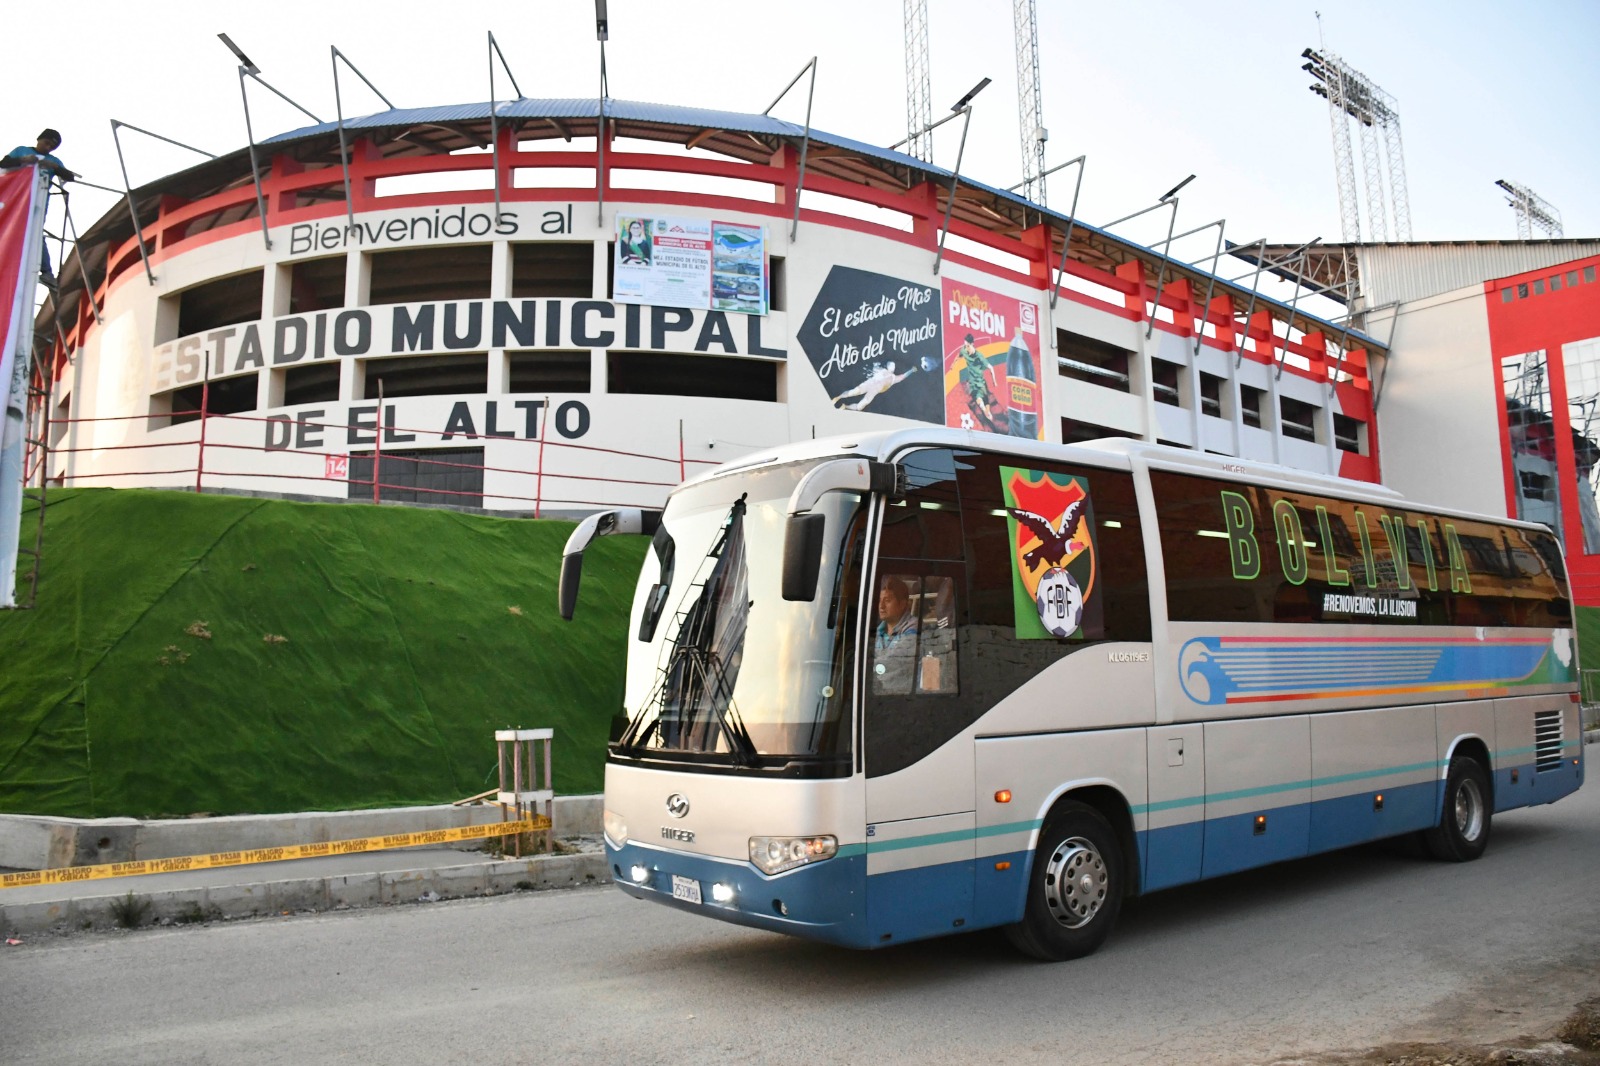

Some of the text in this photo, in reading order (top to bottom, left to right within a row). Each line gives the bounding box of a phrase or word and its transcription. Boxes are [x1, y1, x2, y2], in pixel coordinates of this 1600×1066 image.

[290, 204, 572, 255] Bienvenidos al
[819, 307, 841, 337] El
[844, 295, 897, 328] estadio
[155, 300, 787, 389] ESTADIO MUNICIPAL
[819, 317, 937, 379] Alto del Mundo
[264, 400, 590, 452] DE EL ALTO
[329, 458, 347, 475] 14
[1222, 464, 1246, 475] HIGER
[1220, 490, 1472, 594] BOLIVIA
[1047, 583, 1072, 619] FBF
[1323, 594, 1417, 617] #RENOVEMOS, LA ILUSION
[392, 834, 410, 842] PASAR
[421, 830, 446, 838] PELIGRO
[661, 827, 696, 843] HIGER
[310, 843, 328, 852] PASAR
[341, 839, 368, 848] PELIGRO
[221, 852, 241, 860] PASAR
[253, 848, 283, 856] PELIGRO
[112, 861, 146, 871] NO PASAR
[160, 857, 192, 865] PELIGRO
[3, 872, 41, 882] NO PASAR
[57, 867, 92, 877] PELIGRO
[60, 873, 90, 882] OBRAS
